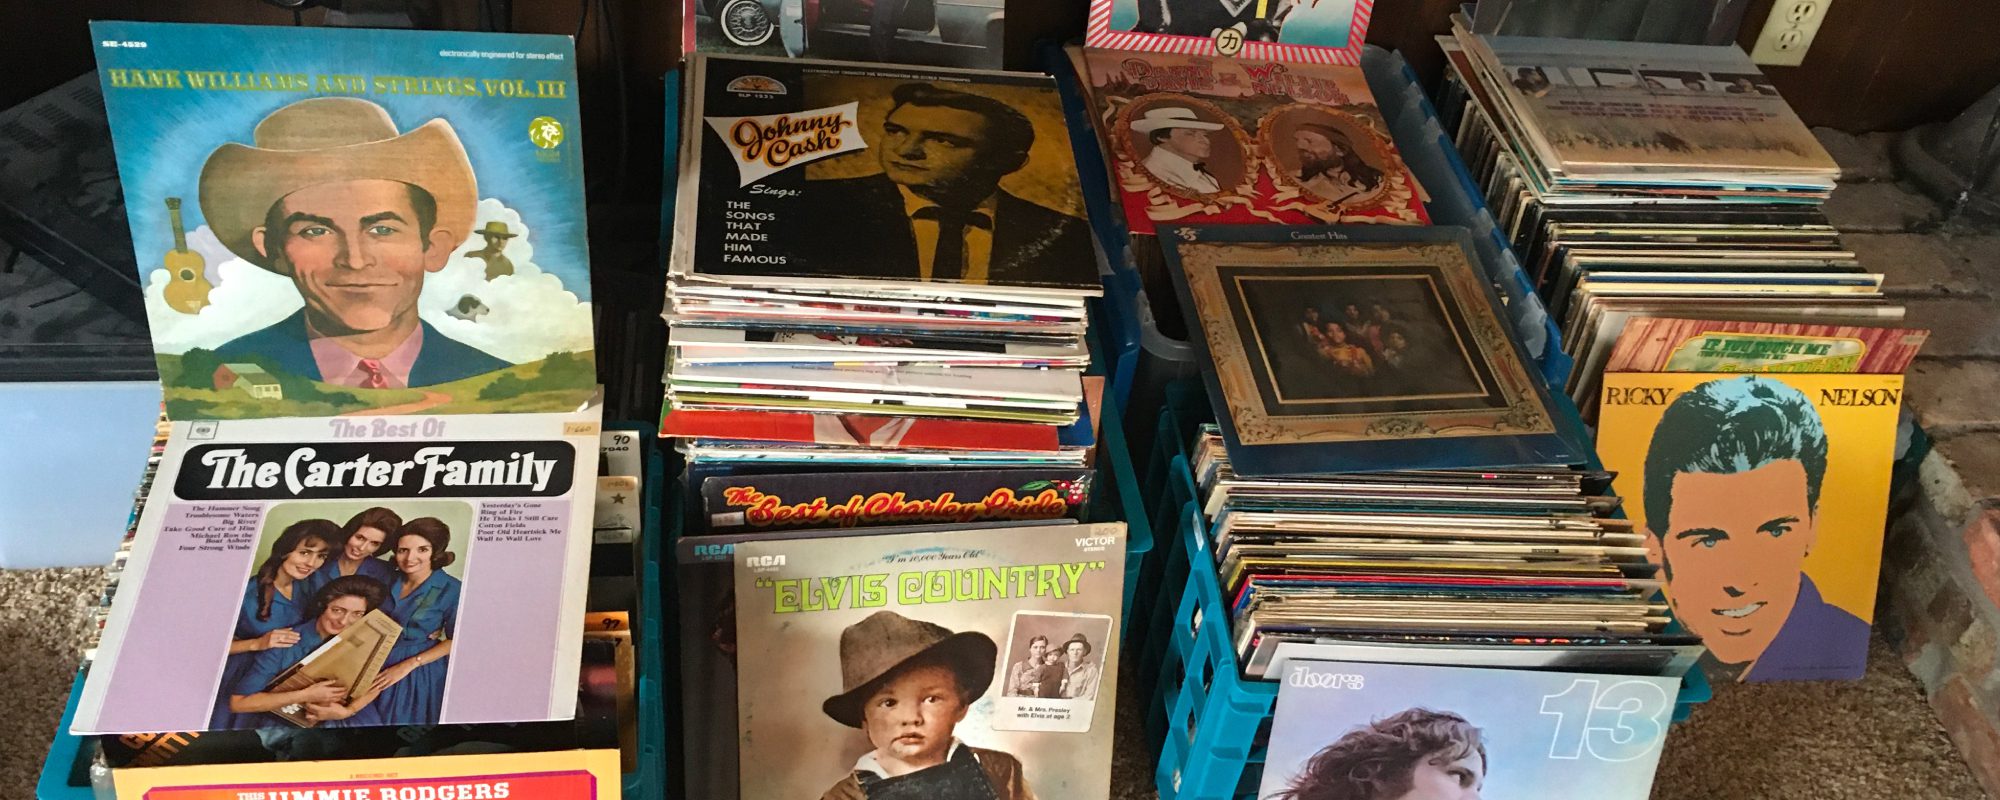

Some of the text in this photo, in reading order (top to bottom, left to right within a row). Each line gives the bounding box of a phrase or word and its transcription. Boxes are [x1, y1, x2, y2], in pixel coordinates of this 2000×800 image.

[102, 40, 147, 48] SE-4529
[439, 49, 480, 58] electronically
[481, 51, 515, 59] engineered
[108, 68, 183, 88] HANK
[185, 70, 309, 91] WILLIAMS
[315, 73, 367, 93] AND
[536, 80, 567, 98] III
[731, 112, 852, 161] Johnny
[764, 130, 842, 168] Cash
[727, 201, 751, 209] THE
[726, 212, 775, 221] SONGS
[726, 222, 761, 230] THAT
[725, 233, 768, 242] MADE
[1327, 231, 1348, 240] Hits
[724, 243, 753, 252] HIM
[723, 254, 787, 265] FAMOUS
[1802, 343, 1832, 356] ME
[1605, 386, 1902, 407] RICKY NELSON
[329, 417, 447, 438] The Best Of
[613, 434, 631, 445] 90
[201, 446, 558, 496] The Carter Family
[724, 486, 764, 506] The
[746, 495, 828, 526] Best
[827, 494, 864, 528] of
[863, 491, 980, 523] Charley
[977, 488, 1068, 520] Pride
[1075, 536, 1115, 547] VICTOR
[694, 543, 735, 556] RCA
[938, 551, 962, 560] Years
[746, 554, 786, 567] RCA
[1288, 666, 1365, 690] doors
[1539, 678, 1668, 763] 13
[237, 792, 265, 800] THIS
[380, 782, 510, 800] RODGERS
